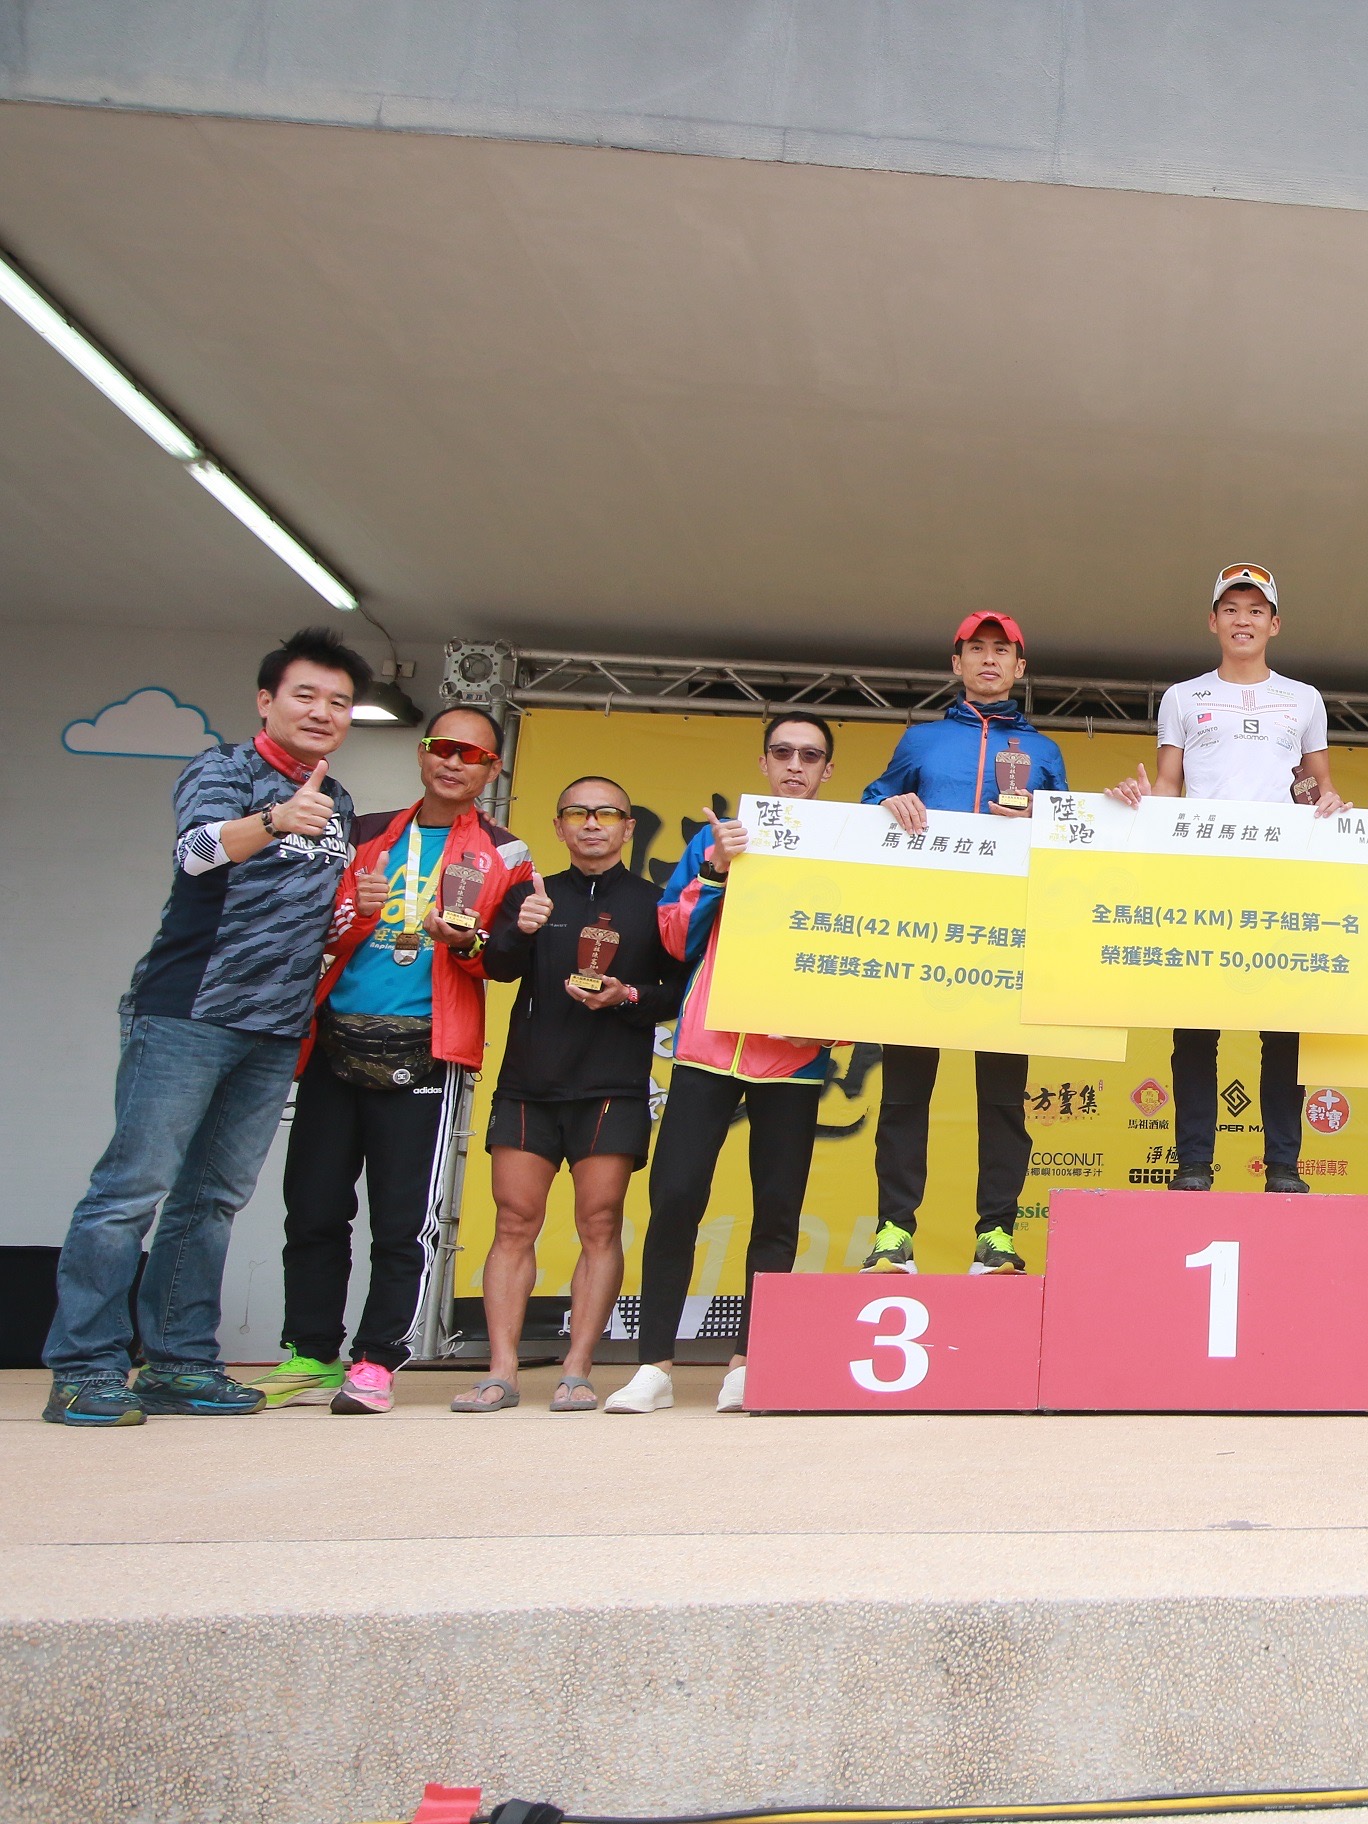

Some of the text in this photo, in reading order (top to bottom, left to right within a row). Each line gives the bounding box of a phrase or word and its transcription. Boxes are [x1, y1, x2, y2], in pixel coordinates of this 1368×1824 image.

[1177, 813, 1216, 822] 第六屆
[1172, 823, 1282, 842] 馬祖馬拉松
[881, 832, 997, 857] 馬祖馬拉松
[1239, 911, 1360, 935] 男子組第一名
[1219, 951, 1350, 974] 50,000元獎金
[1024, 1083, 1098, 1115] 方雲集
[1128, 1119, 1169, 1130] 馬祖酒廠
[1031, 1152, 1103, 1166] COCONUT
[1184, 1240, 1240, 1359] 1
[849, 1295, 931, 1393] 3
